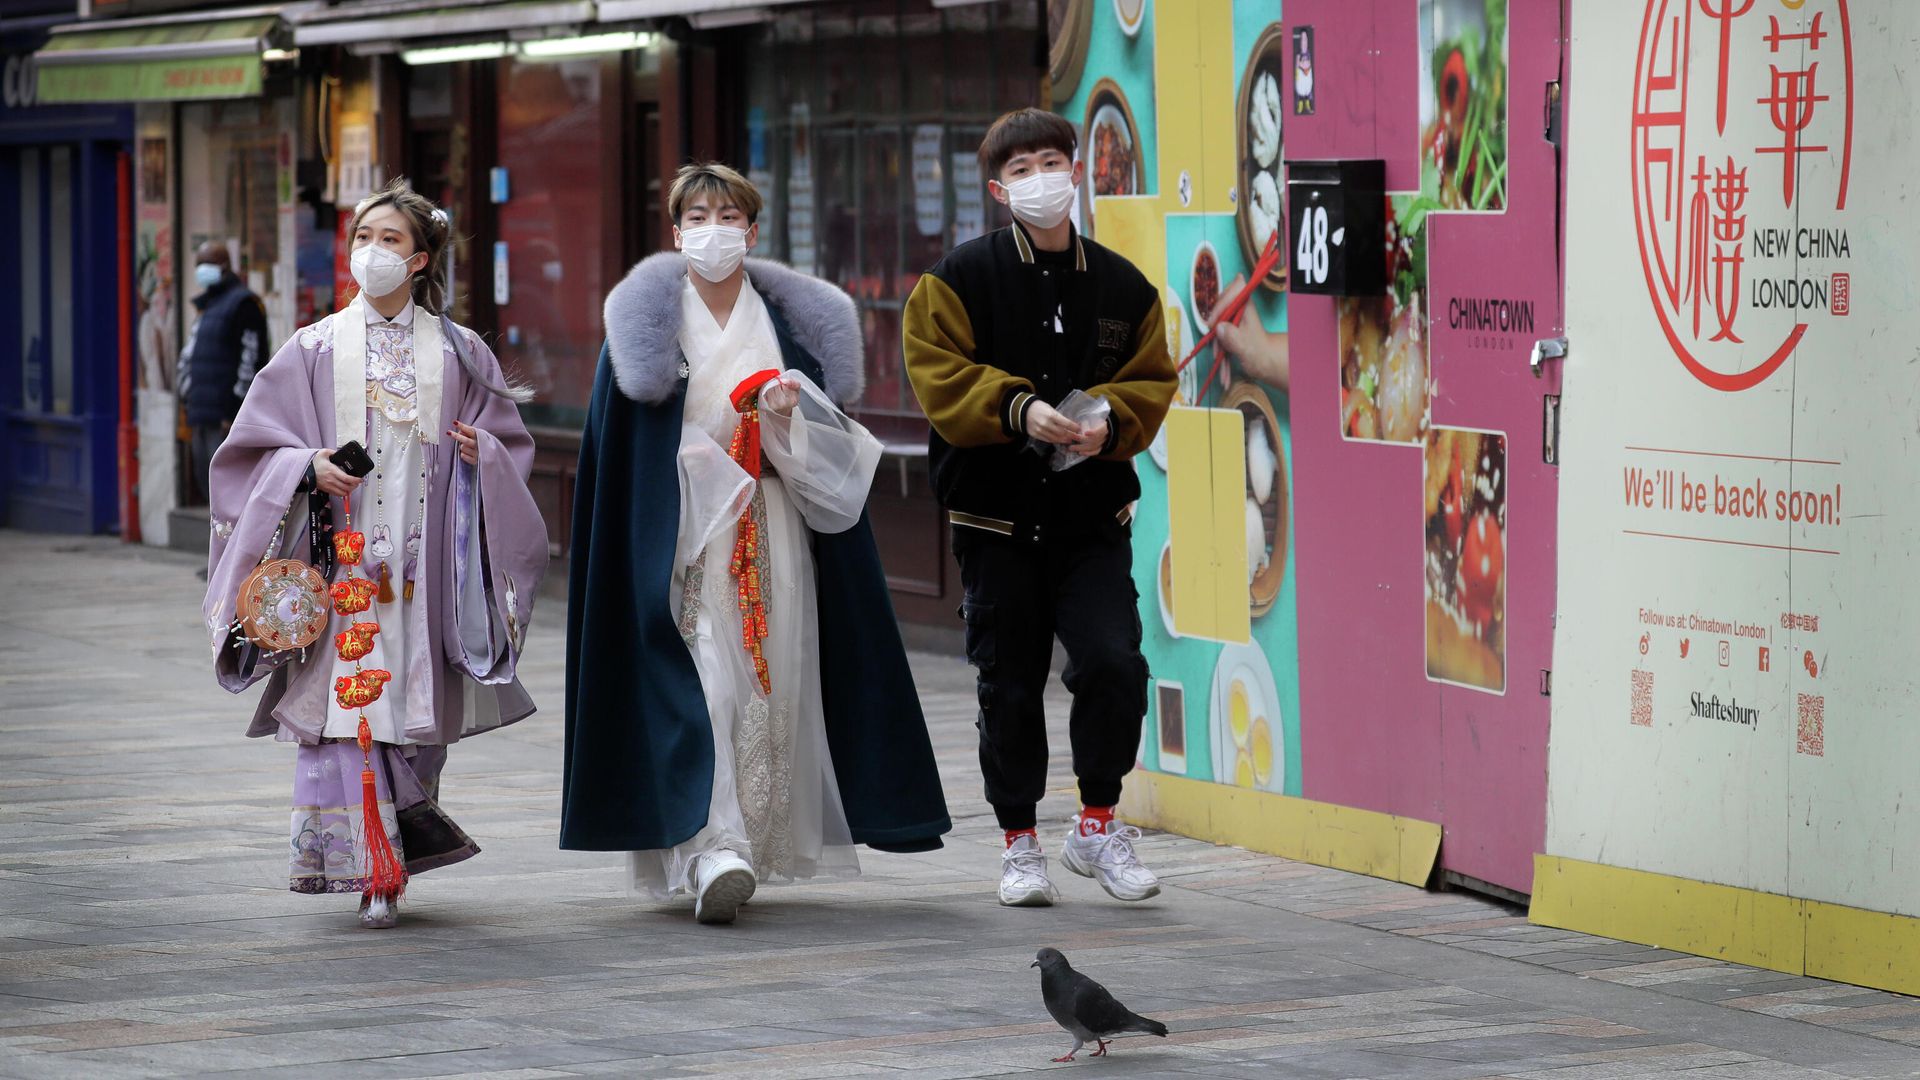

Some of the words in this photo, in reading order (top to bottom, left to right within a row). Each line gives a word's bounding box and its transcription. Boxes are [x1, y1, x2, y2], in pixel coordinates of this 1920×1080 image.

[1297, 206, 1329, 284] 48
[1753, 228, 1791, 258] NEW
[1796, 228, 1850, 259] CHINA
[1752, 278, 1827, 309] LONDON
[1449, 297, 1534, 334] CHINATOWN
[1468, 335, 1514, 351] LONDON
[1624, 466, 1674, 510] We'll
[1681, 472, 1707, 514] be
[1714, 474, 1768, 519] back
[1775, 483, 1841, 526] soon!
[1639, 608, 1664, 627] Follow
[1666, 614, 1676, 628] us
[1677, 614, 1687, 629] at:
[1689, 613, 1732, 636] Chinatown
[1734, 620, 1766, 640] London
[1690, 691, 1760, 731] Shaftesbury
